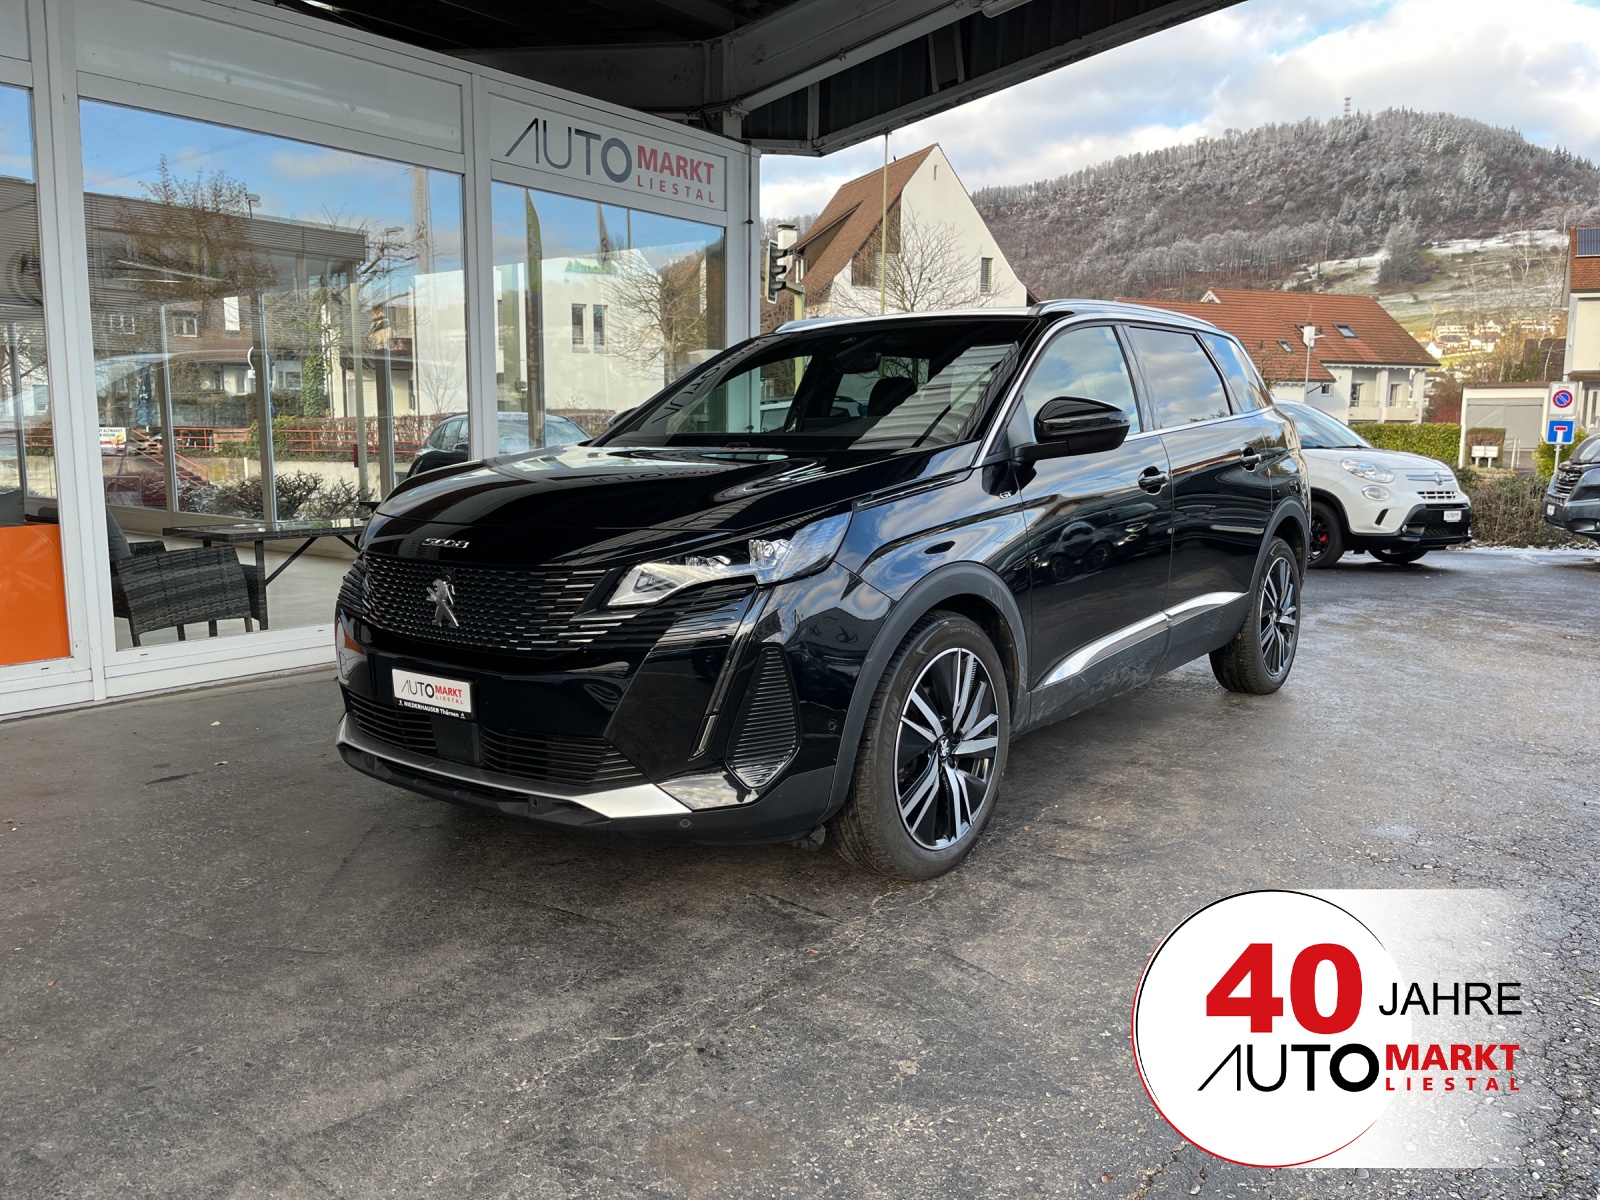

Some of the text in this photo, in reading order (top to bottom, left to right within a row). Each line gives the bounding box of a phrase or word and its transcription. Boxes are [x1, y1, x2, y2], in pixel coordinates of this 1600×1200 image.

[504, 117, 715, 185] AUTO MARKT
[637, 175, 715, 204] LIESTAL
[421, 537, 470, 549] 5008
[401, 679, 462, 698] AUTO MARKT
[403, 701, 439, 713] NIEDERHAUSER
[435, 695, 463, 705] LIESTAL
